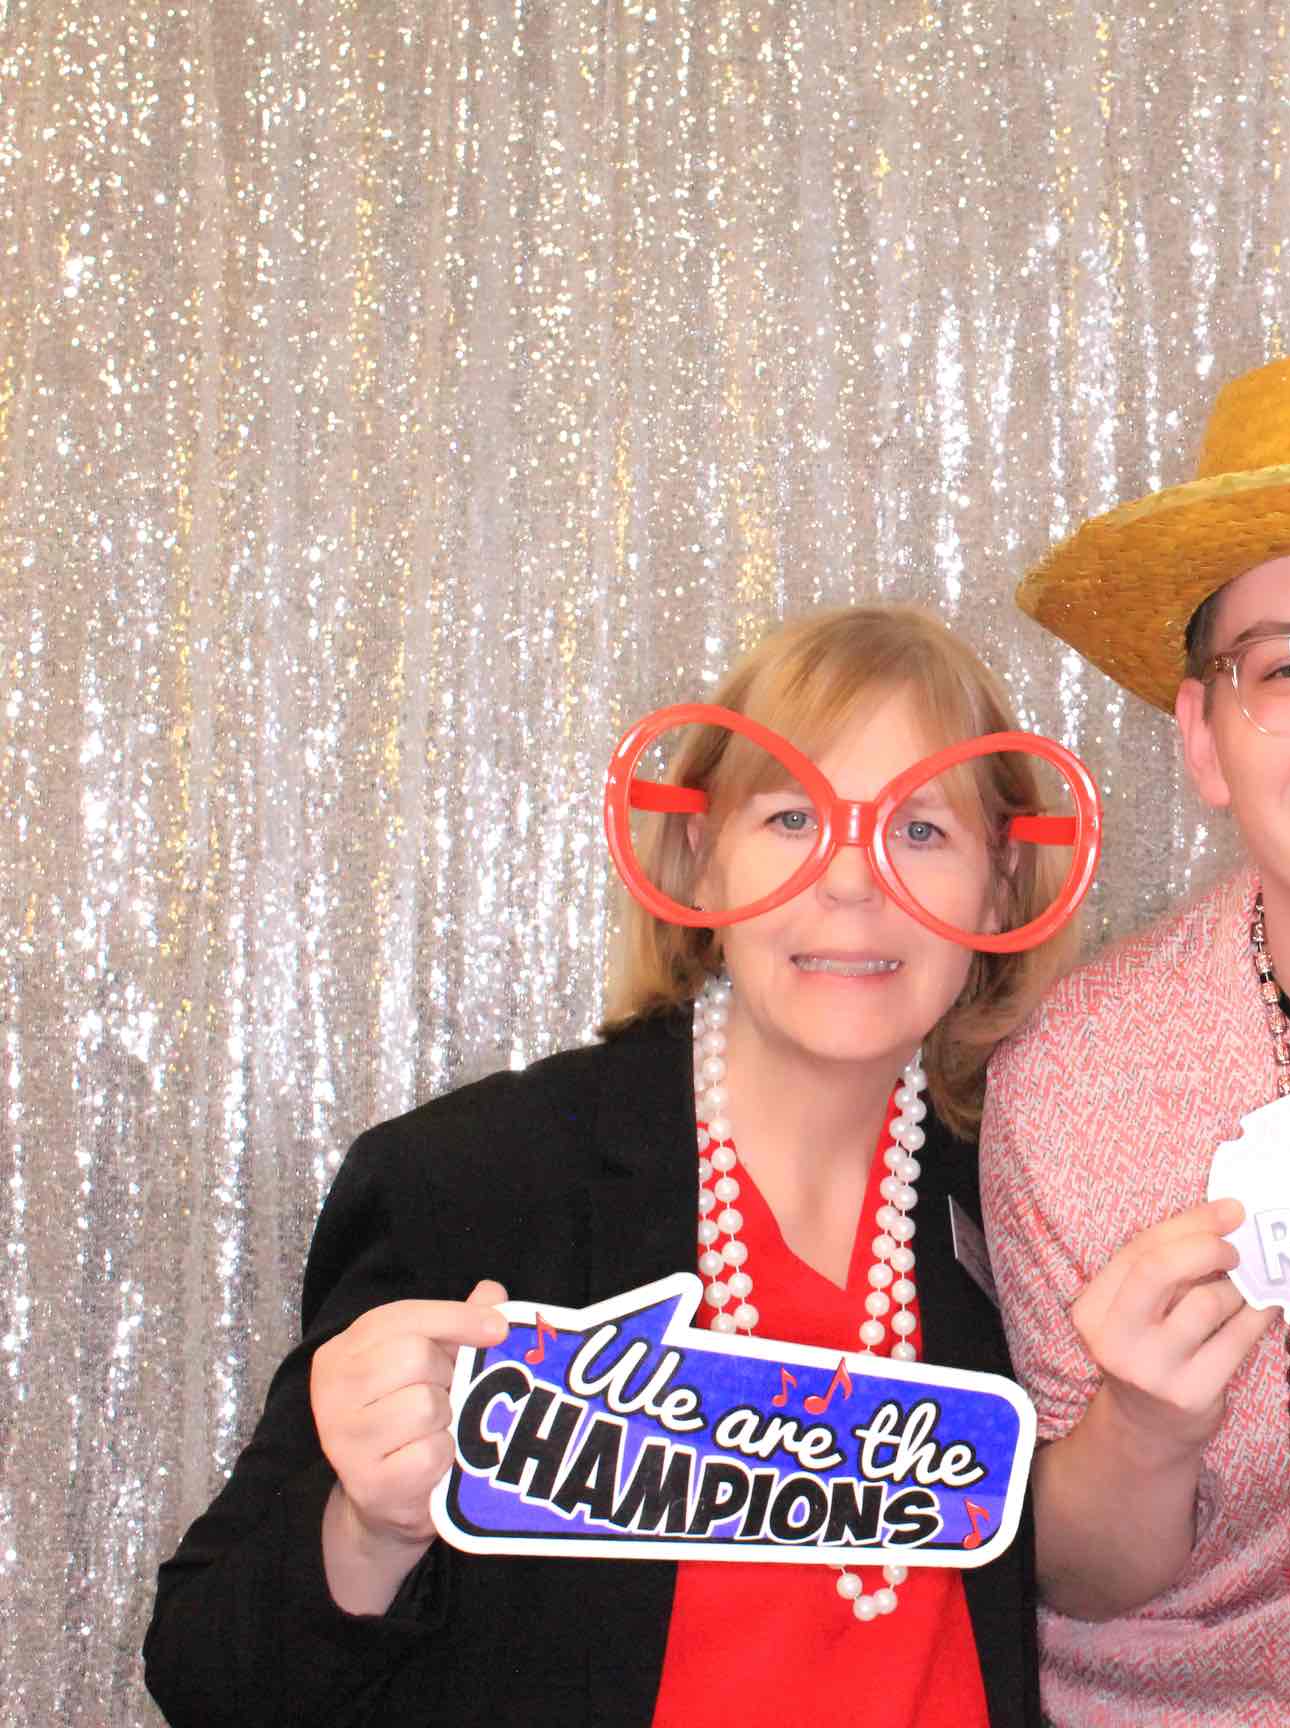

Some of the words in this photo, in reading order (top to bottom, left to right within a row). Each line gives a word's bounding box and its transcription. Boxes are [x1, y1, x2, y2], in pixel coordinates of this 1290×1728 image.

[455, 1362, 944, 1549] CHAMPIONS
[568, 1323, 704, 1433] We
[714, 1408, 848, 1472] are
[857, 1402, 986, 1487] the
